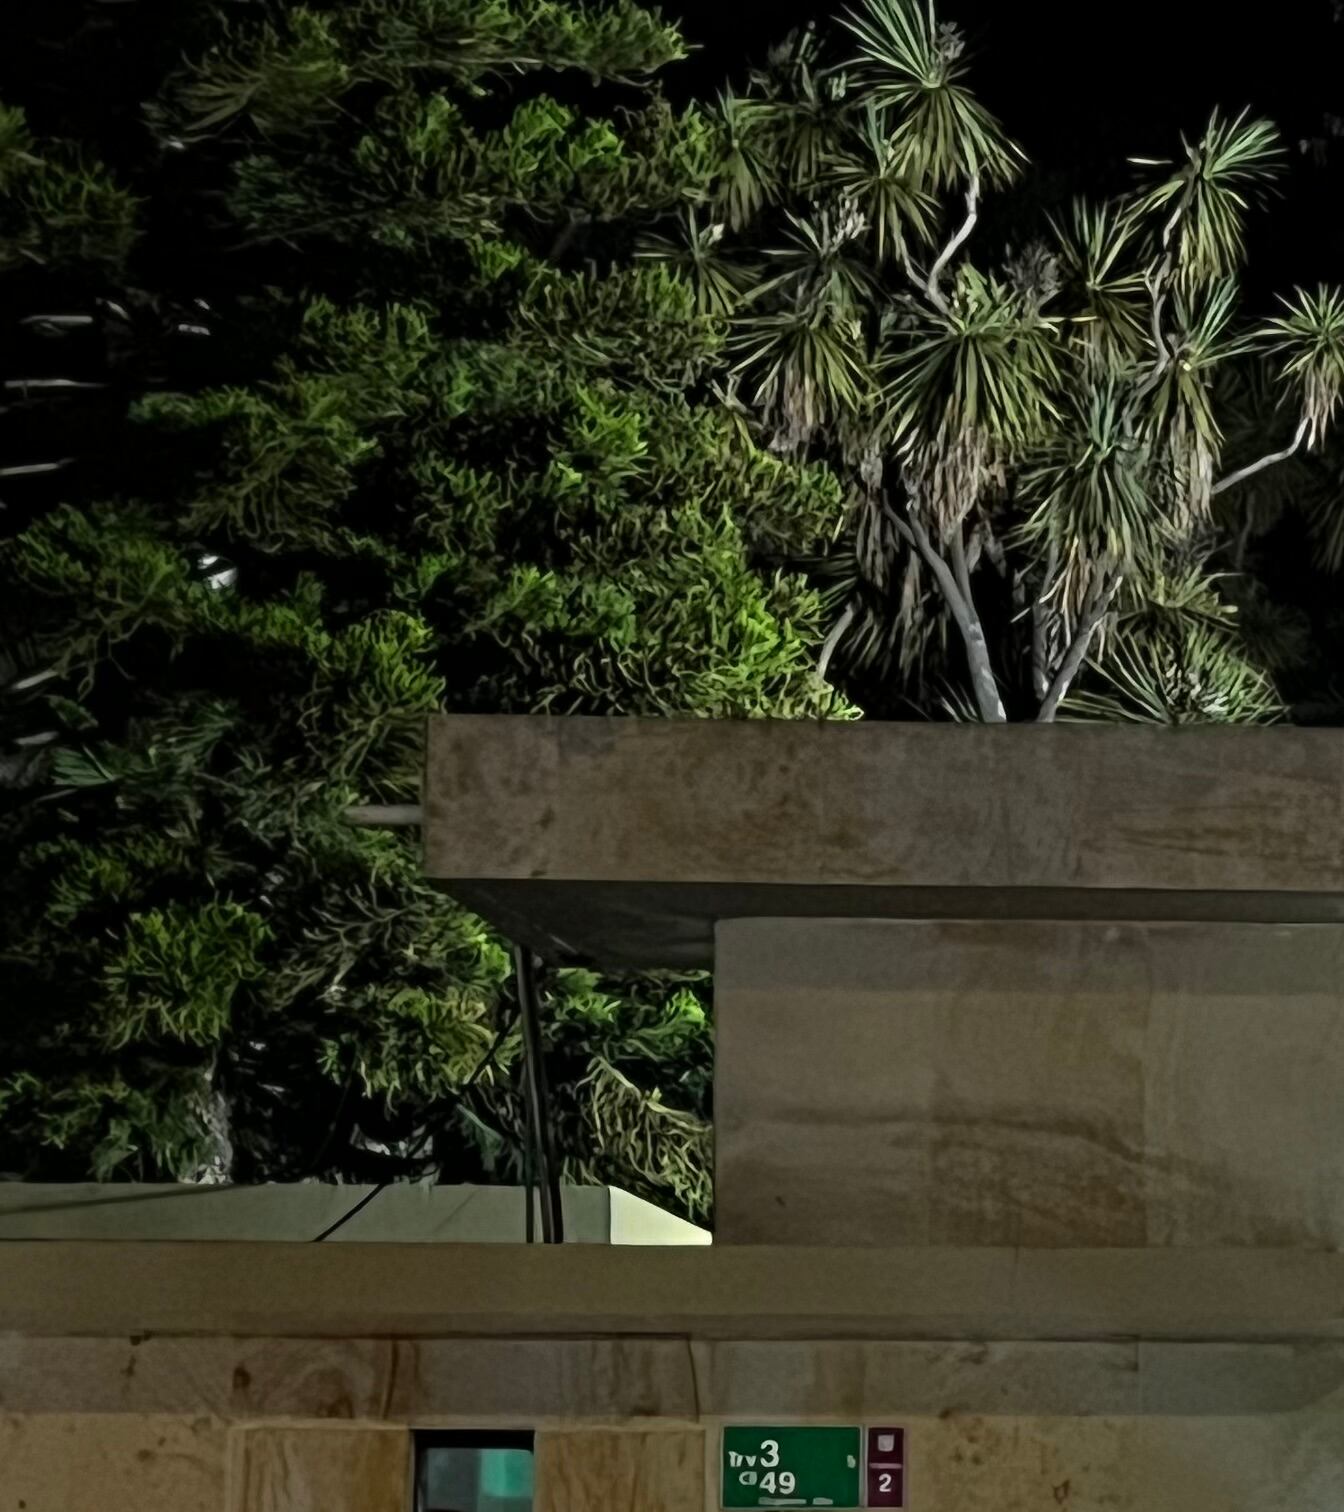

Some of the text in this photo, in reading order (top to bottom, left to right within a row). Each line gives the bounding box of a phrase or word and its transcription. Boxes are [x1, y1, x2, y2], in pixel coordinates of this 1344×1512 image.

[760, 1439, 779, 1468] 3
[759, 1472, 796, 1495] 49
[878, 1473, 892, 1493] 2
